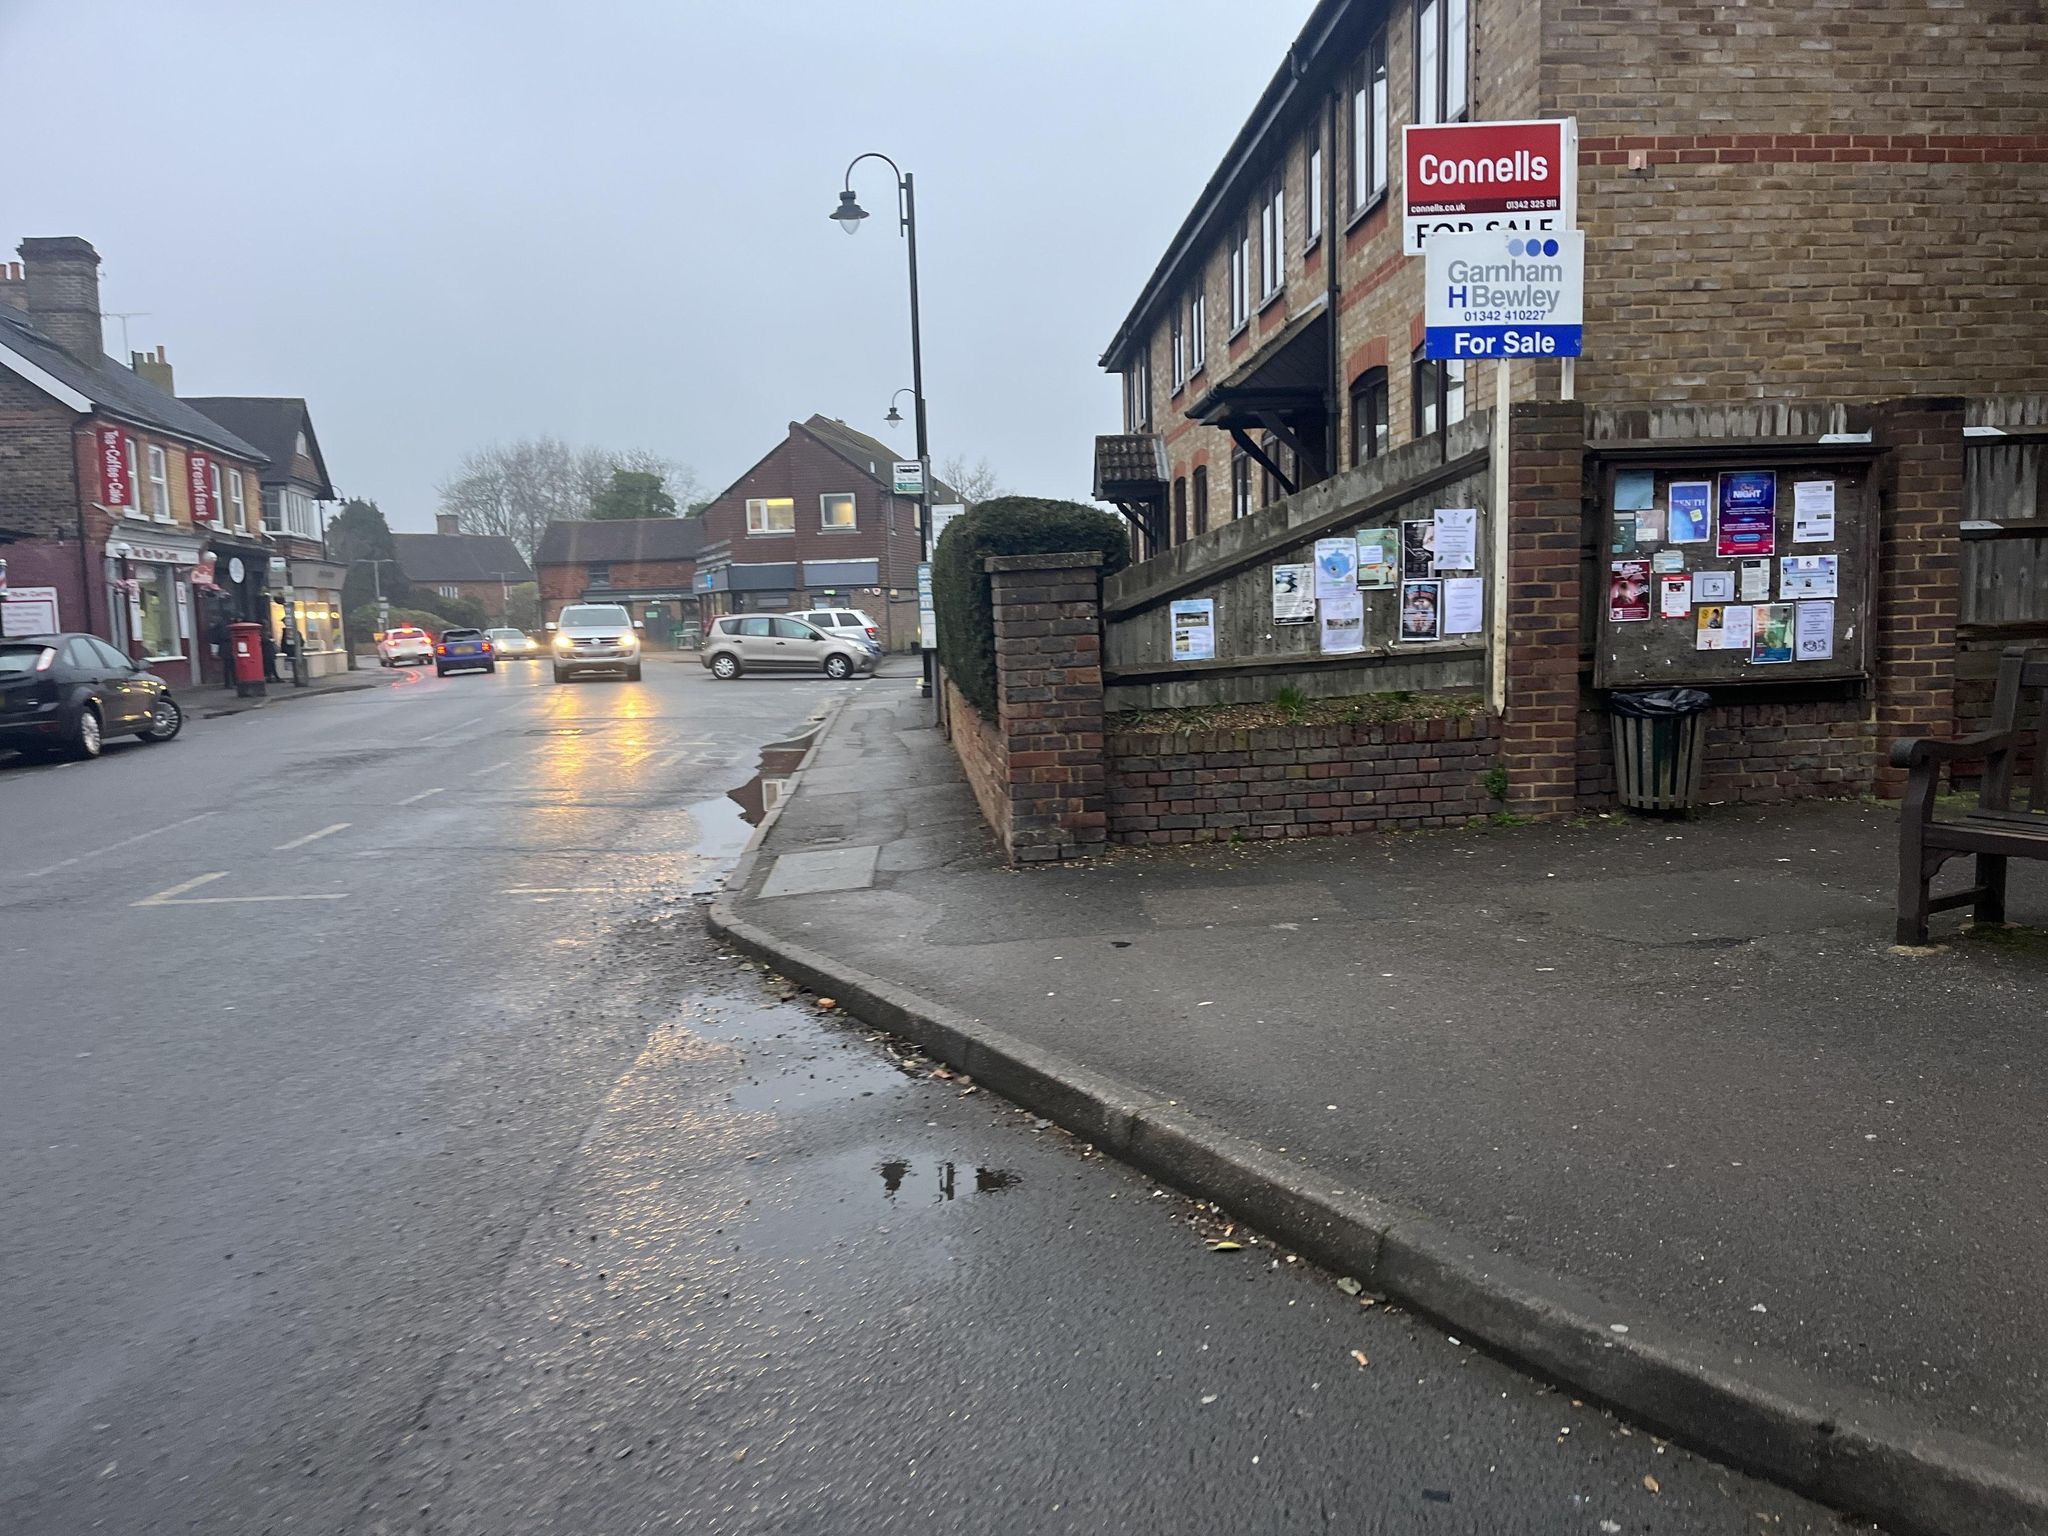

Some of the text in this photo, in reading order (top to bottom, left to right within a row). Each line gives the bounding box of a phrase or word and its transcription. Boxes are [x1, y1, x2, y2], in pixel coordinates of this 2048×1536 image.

[1419, 150, 1549, 185] Connells
[1410, 203, 1466, 213] connells.co.uk
[1506, 201, 1529, 210] 01342
[1530, 200, 1545, 209] 325
[1448, 259, 1562, 284] Garnham
[1448, 284, 1560, 313] H Bewley
[1464, 310, 1546, 322] 01342 410227
[1454, 330, 1556, 354] For Sale
[191, 457, 209, 516] Breakfast
[1732, 489, 1762, 499] NIGHT
